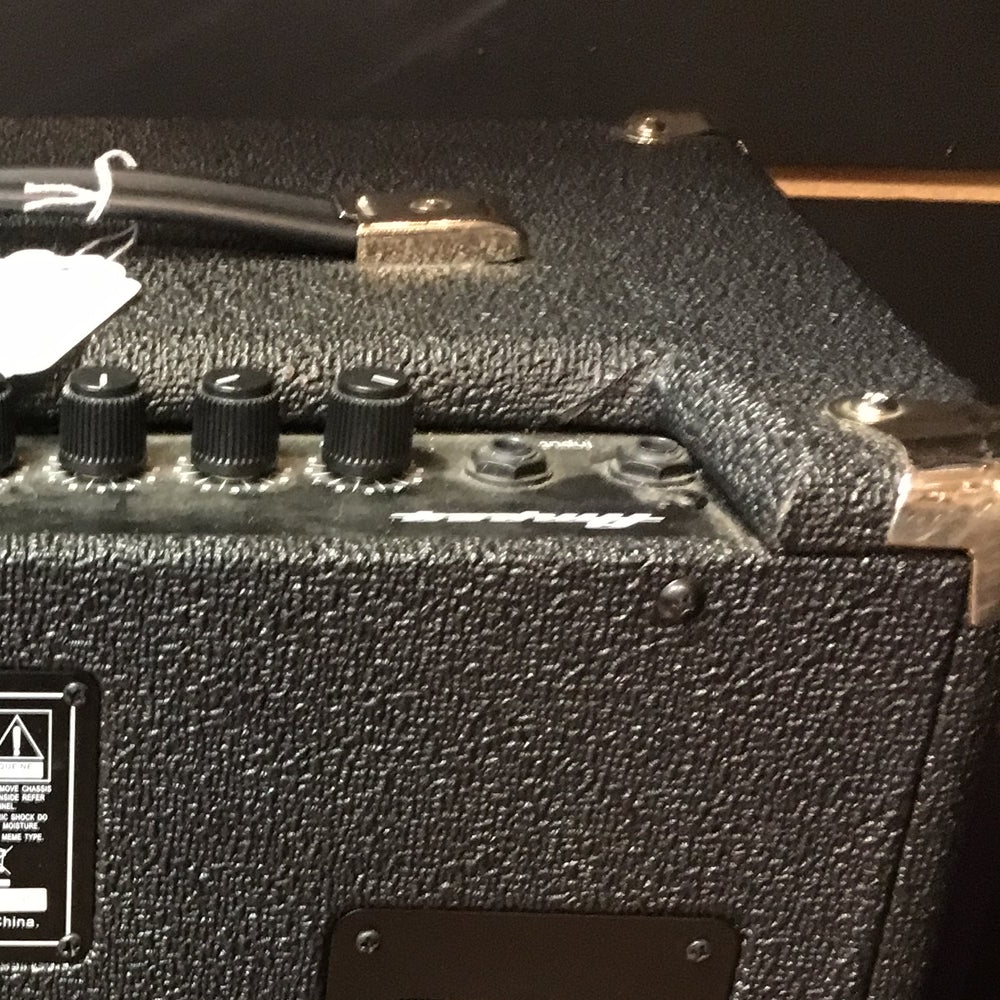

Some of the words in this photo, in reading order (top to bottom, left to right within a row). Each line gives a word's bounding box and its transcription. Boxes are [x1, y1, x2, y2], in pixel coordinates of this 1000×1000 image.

[390, 510, 666, 530] Ampeg
[21, 784, 52, 793] CHASSIS
[22, 794, 45, 802] REFER
[11, 813, 35, 822] SHOCK
[37, 814, 48, 822] DO
